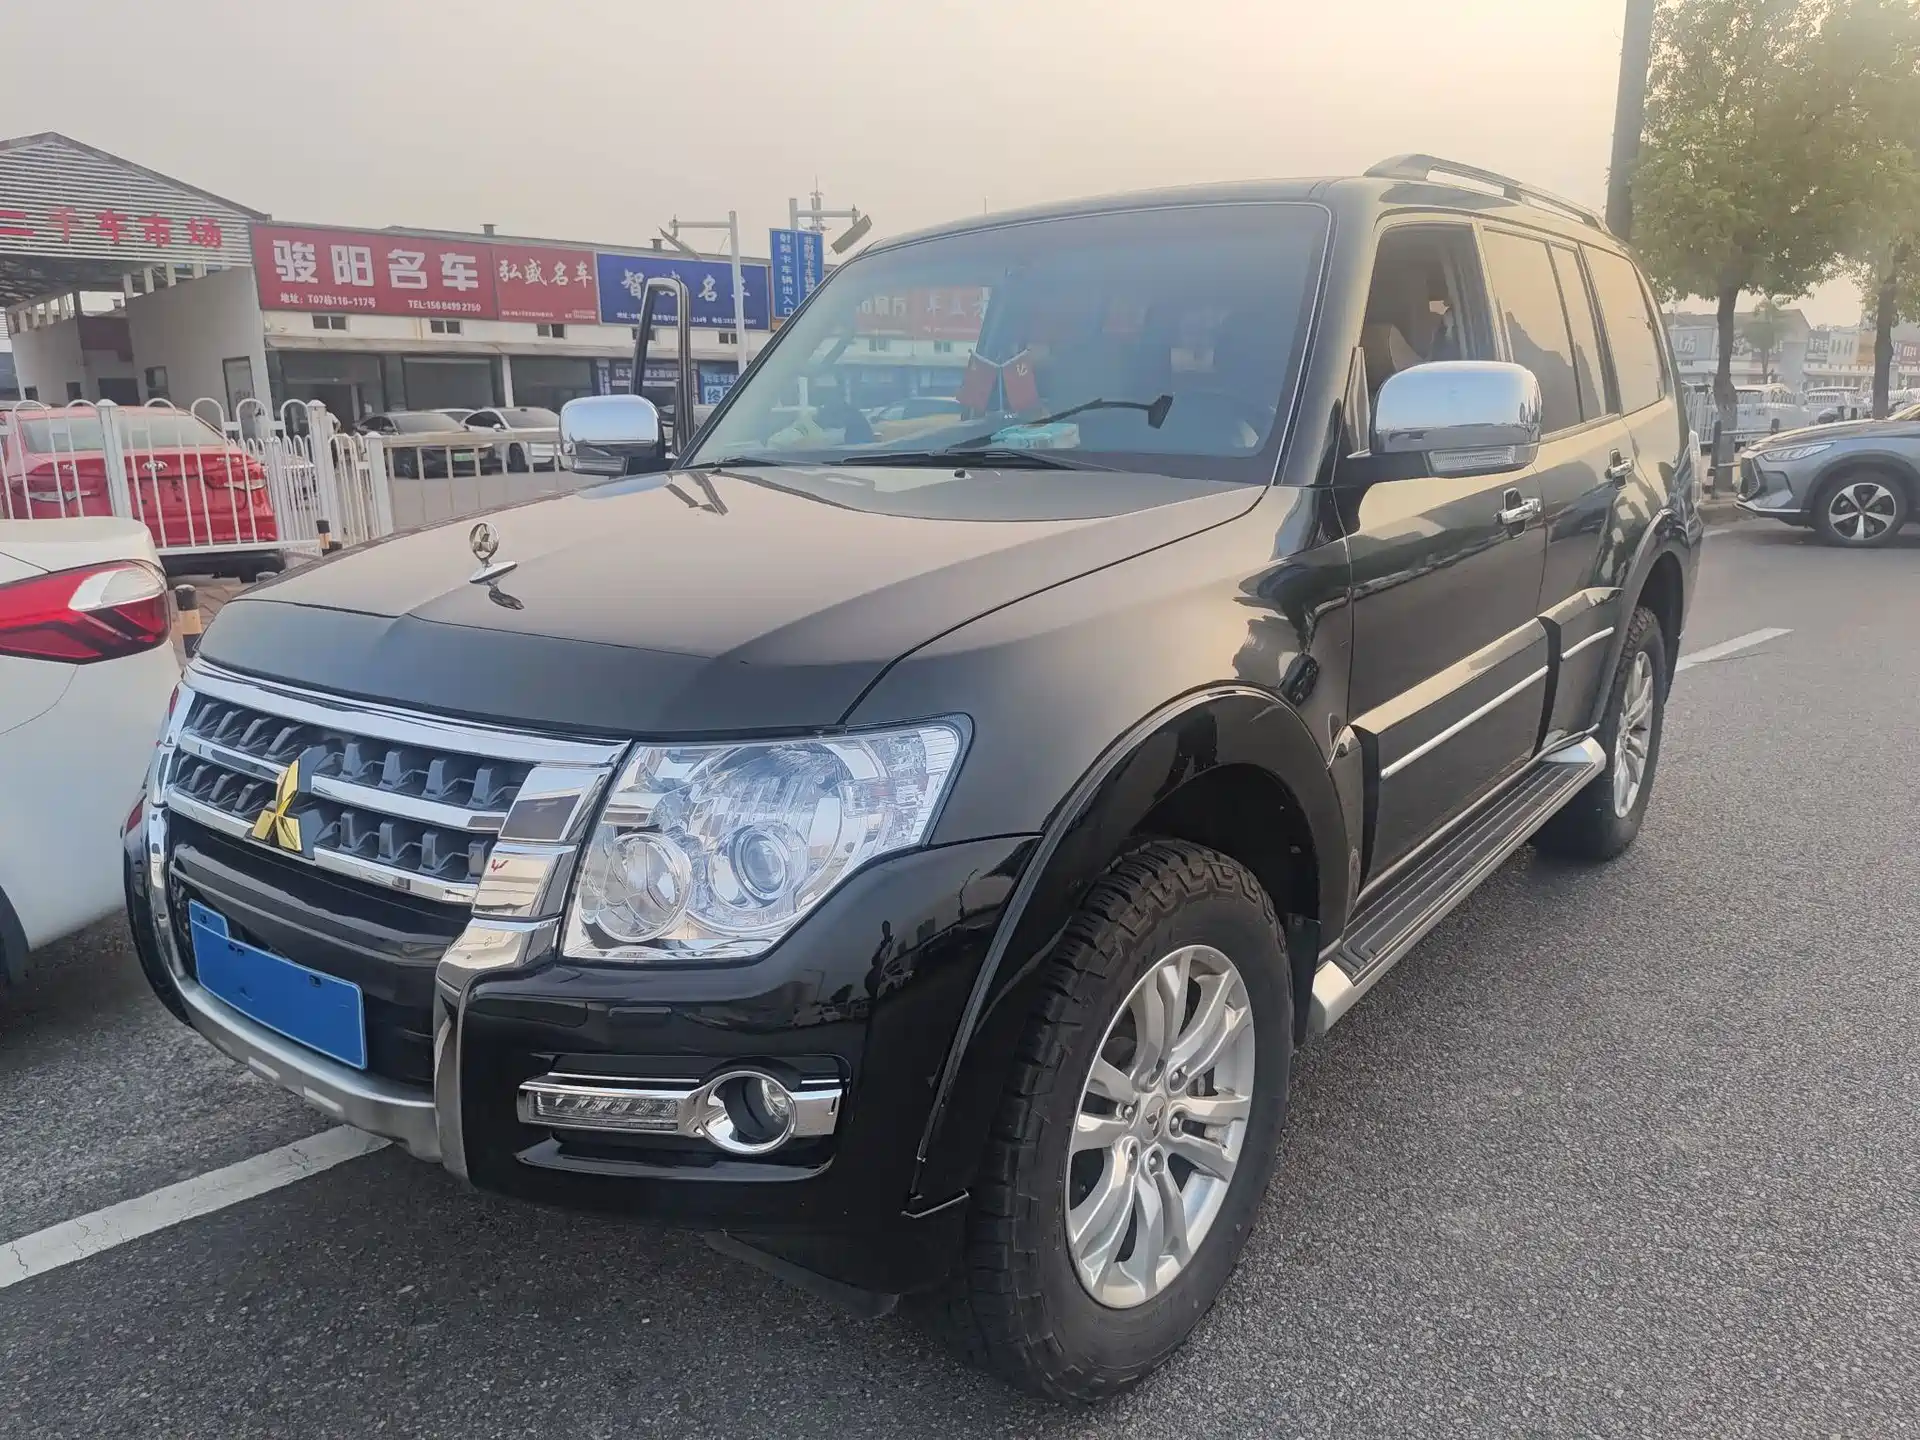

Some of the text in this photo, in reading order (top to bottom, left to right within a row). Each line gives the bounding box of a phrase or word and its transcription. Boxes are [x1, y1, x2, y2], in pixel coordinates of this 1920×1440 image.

[0, 205, 223, 249] 二手车市场
[272, 239, 479, 291] 骏阳名车
[499, 258, 593, 289] 弘盛名车
[620, 268, 751, 302] 智名
